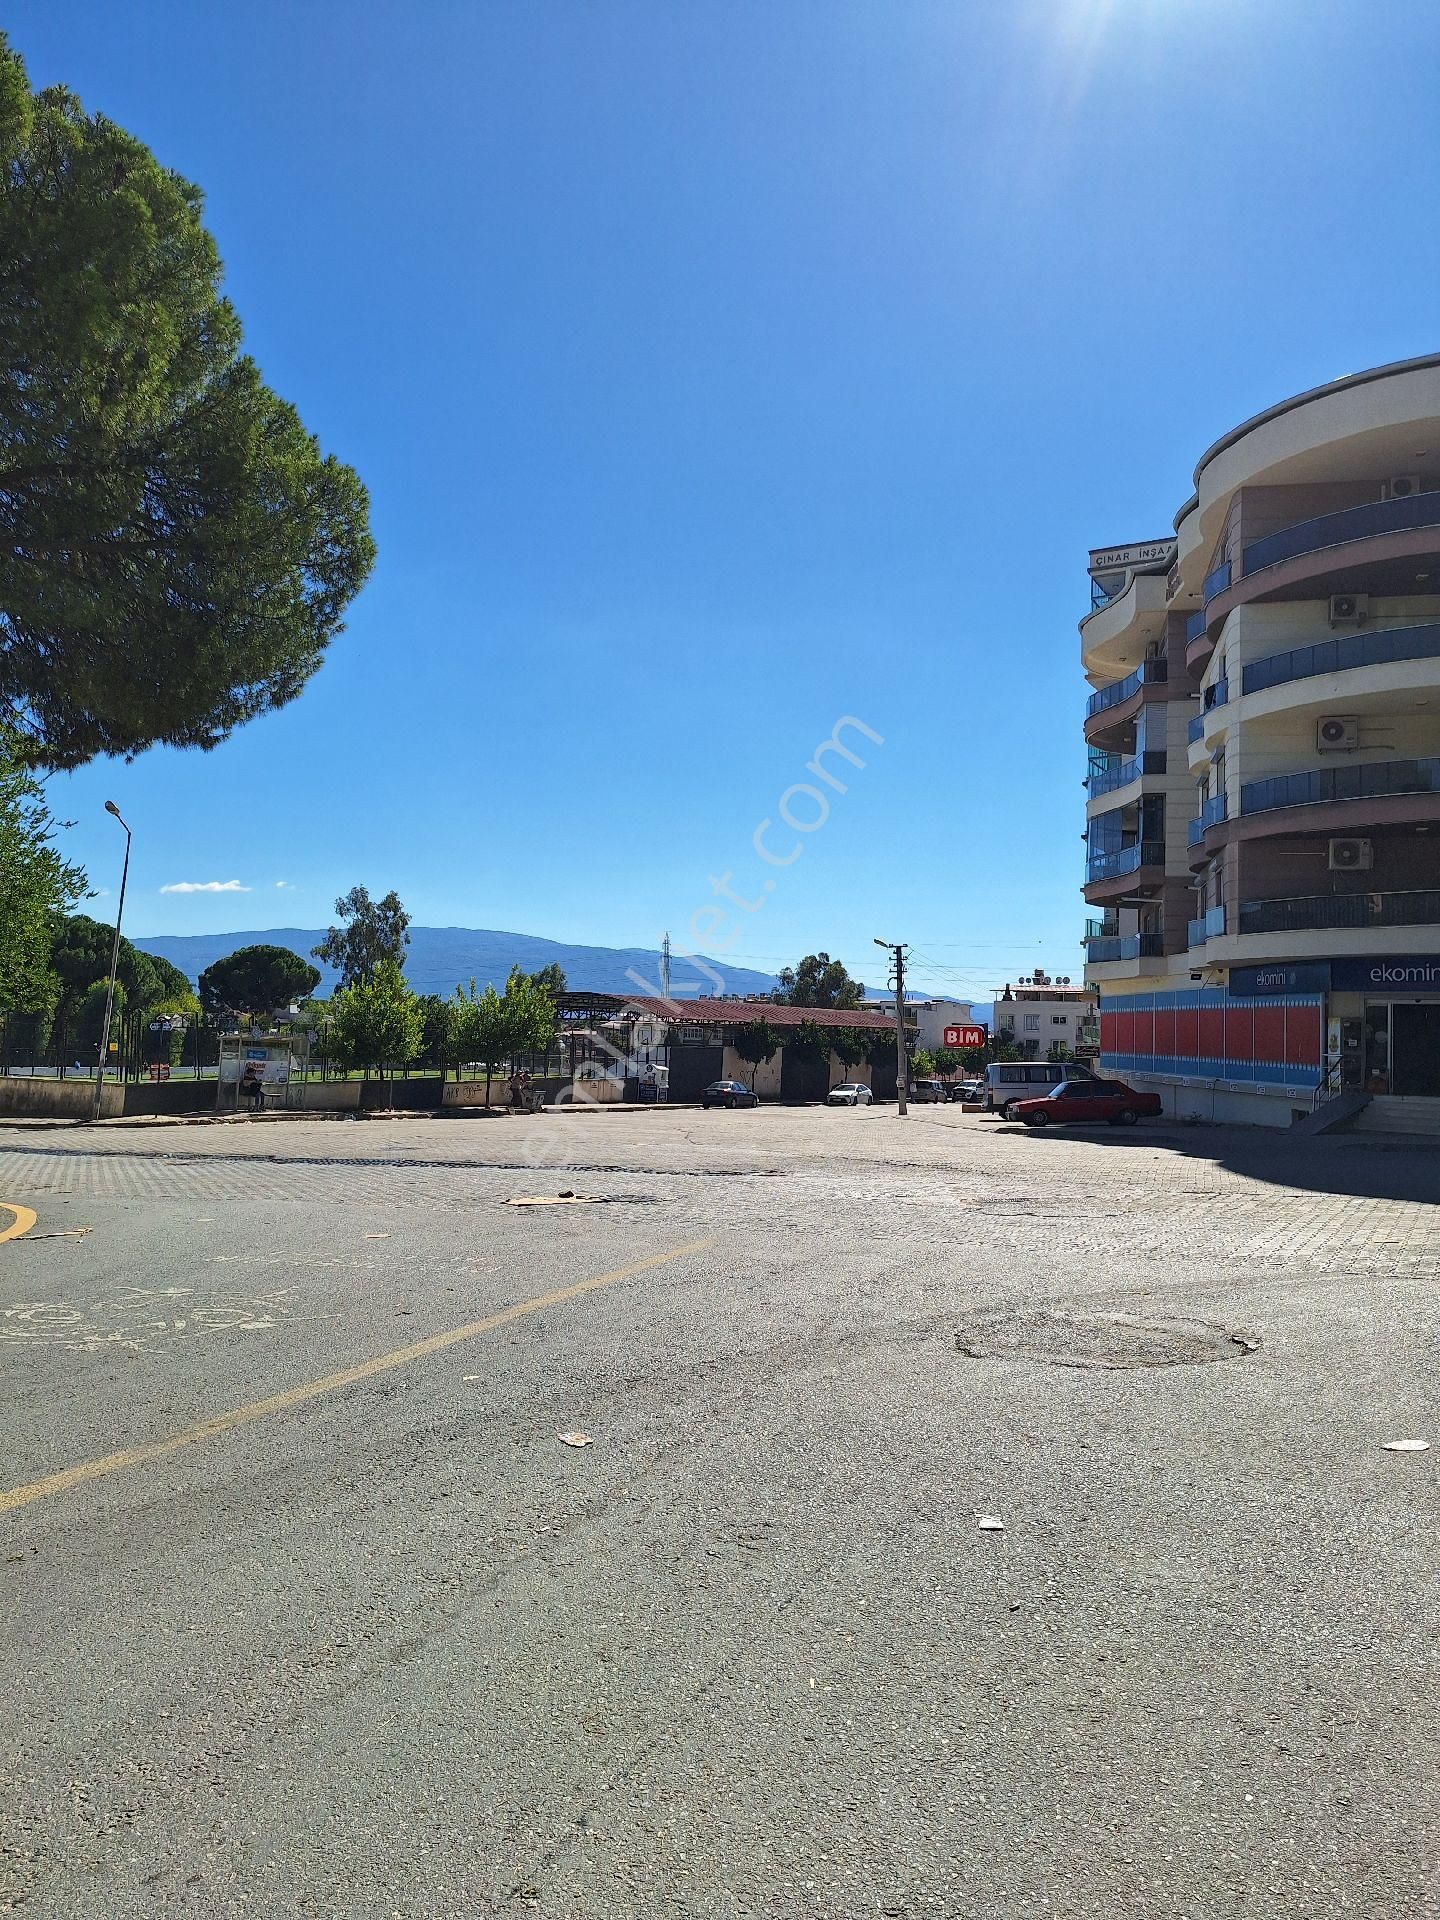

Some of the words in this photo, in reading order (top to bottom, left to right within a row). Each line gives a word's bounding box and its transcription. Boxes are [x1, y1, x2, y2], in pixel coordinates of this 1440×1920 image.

[1096, 552, 1130, 565] ÇINAR
[1256, 969, 1286, 986] ekomini
[947, 1027, 979, 1044] BİM
